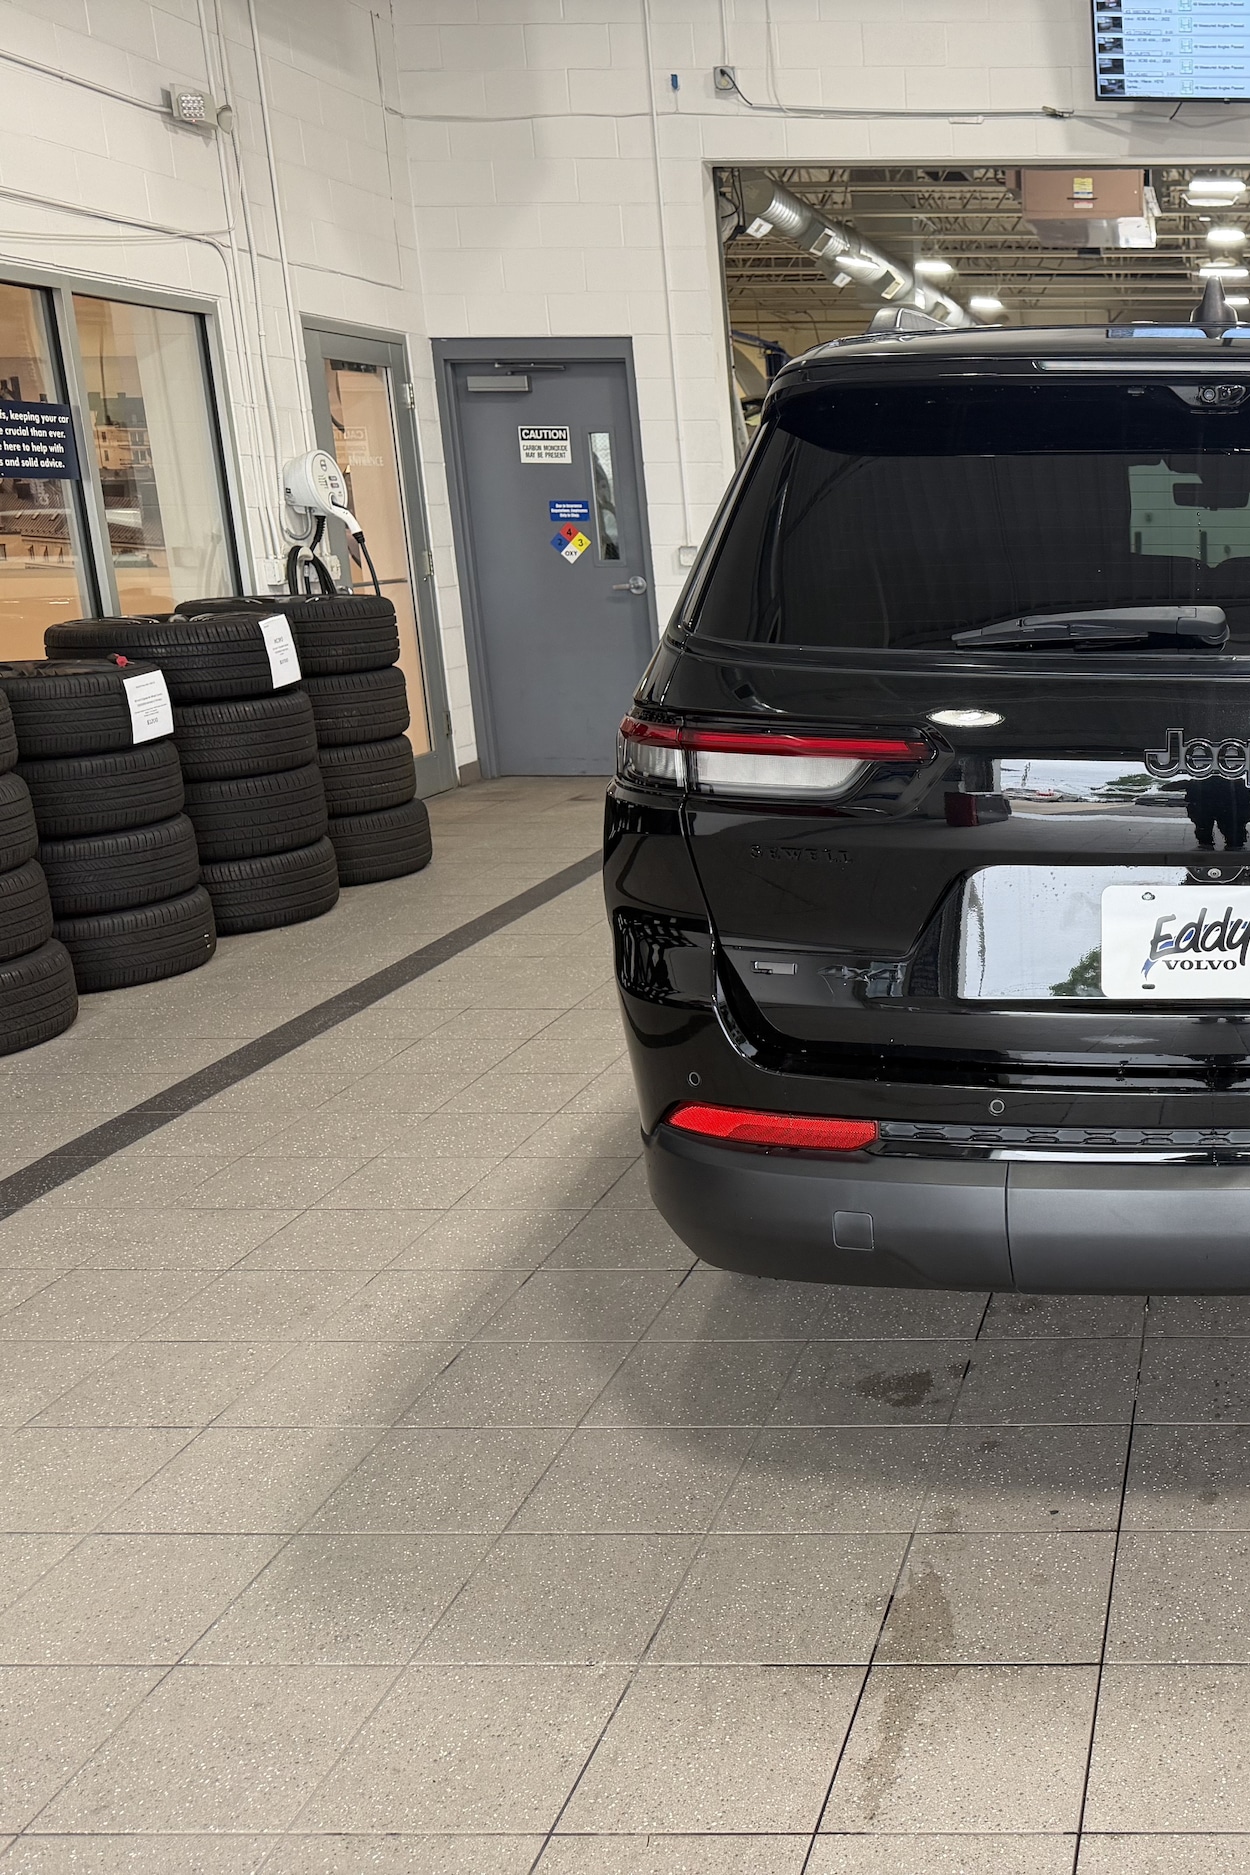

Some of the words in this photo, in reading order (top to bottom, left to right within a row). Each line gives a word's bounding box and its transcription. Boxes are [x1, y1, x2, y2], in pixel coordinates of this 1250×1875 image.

[9, 410, 40, 424] keeping
[41, 414, 57, 424] your
[5, 426, 29, 436] crucial
[30, 427, 47, 437] than
[48, 430, 66, 438] ever.
[522, 430, 567, 439] CAUTION
[3, 441, 21, 451] here
[22, 443, 30, 451] to
[31, 442, 48, 454] help
[49, 443, 64, 453] with
[5, 457, 20, 466] and
[21, 458, 39, 467] solid
[40, 458, 65, 468] advice.
[566, 528, 572, 536] 4
[751, 845, 853, 863] SEWELL
[1162, 959, 1237, 970] VOLVO
